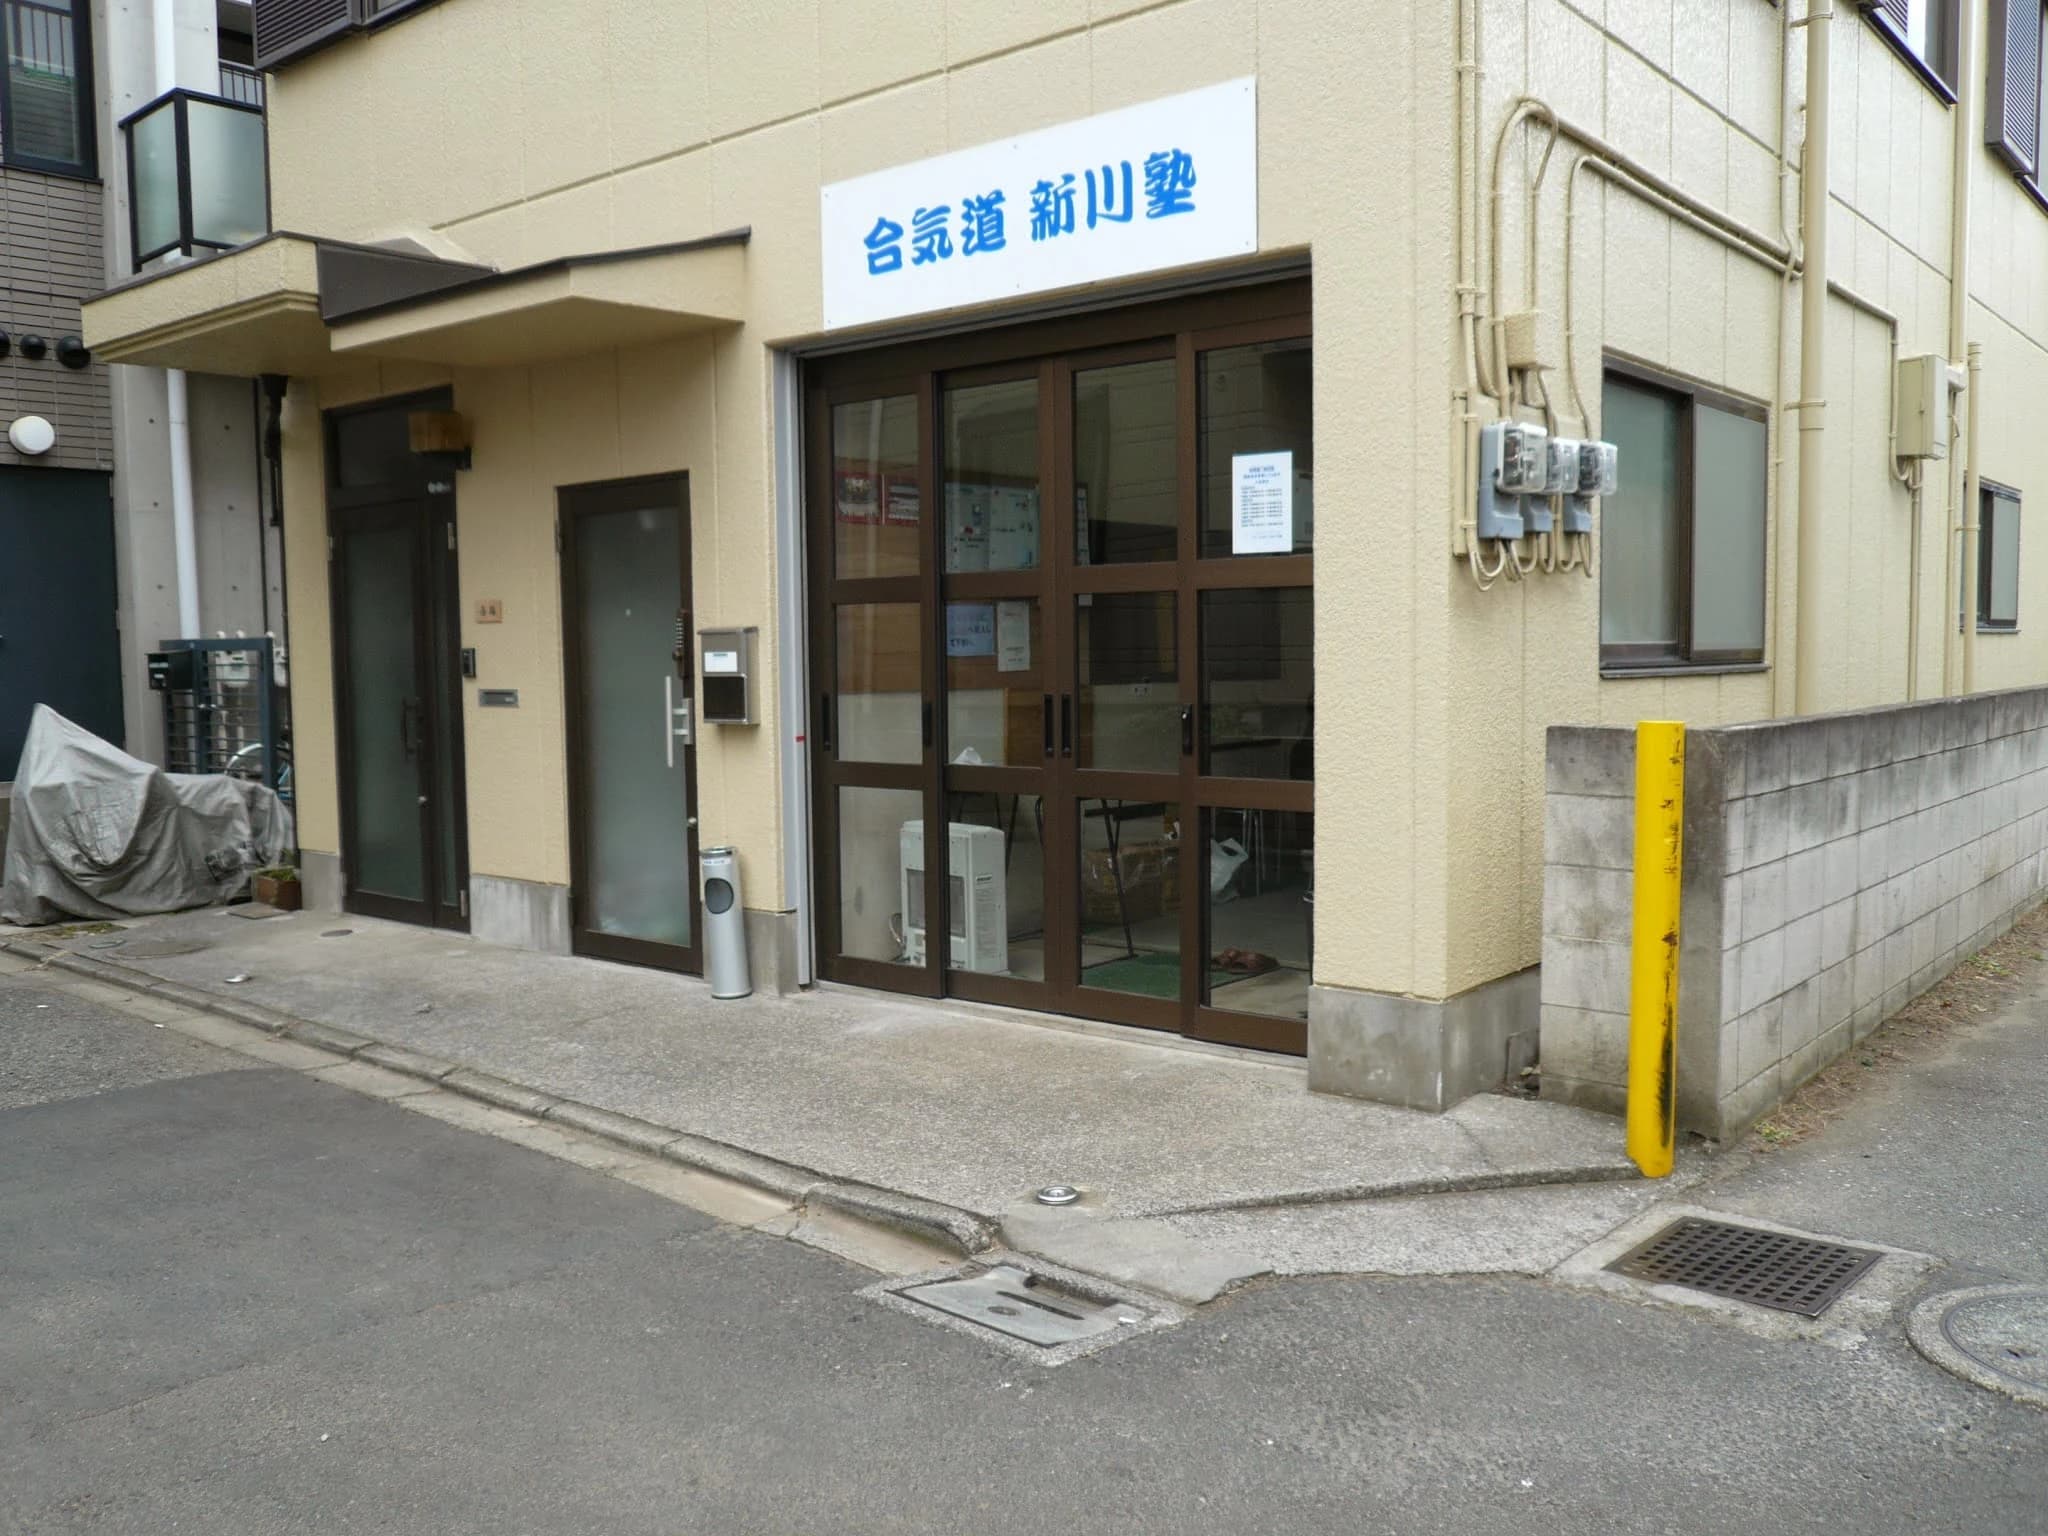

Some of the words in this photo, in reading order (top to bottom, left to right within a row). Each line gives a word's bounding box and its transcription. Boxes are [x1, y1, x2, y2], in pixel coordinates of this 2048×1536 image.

[864, 189, 1007, 276] 合気道
[1030, 148, 1197, 241] 新川塾
